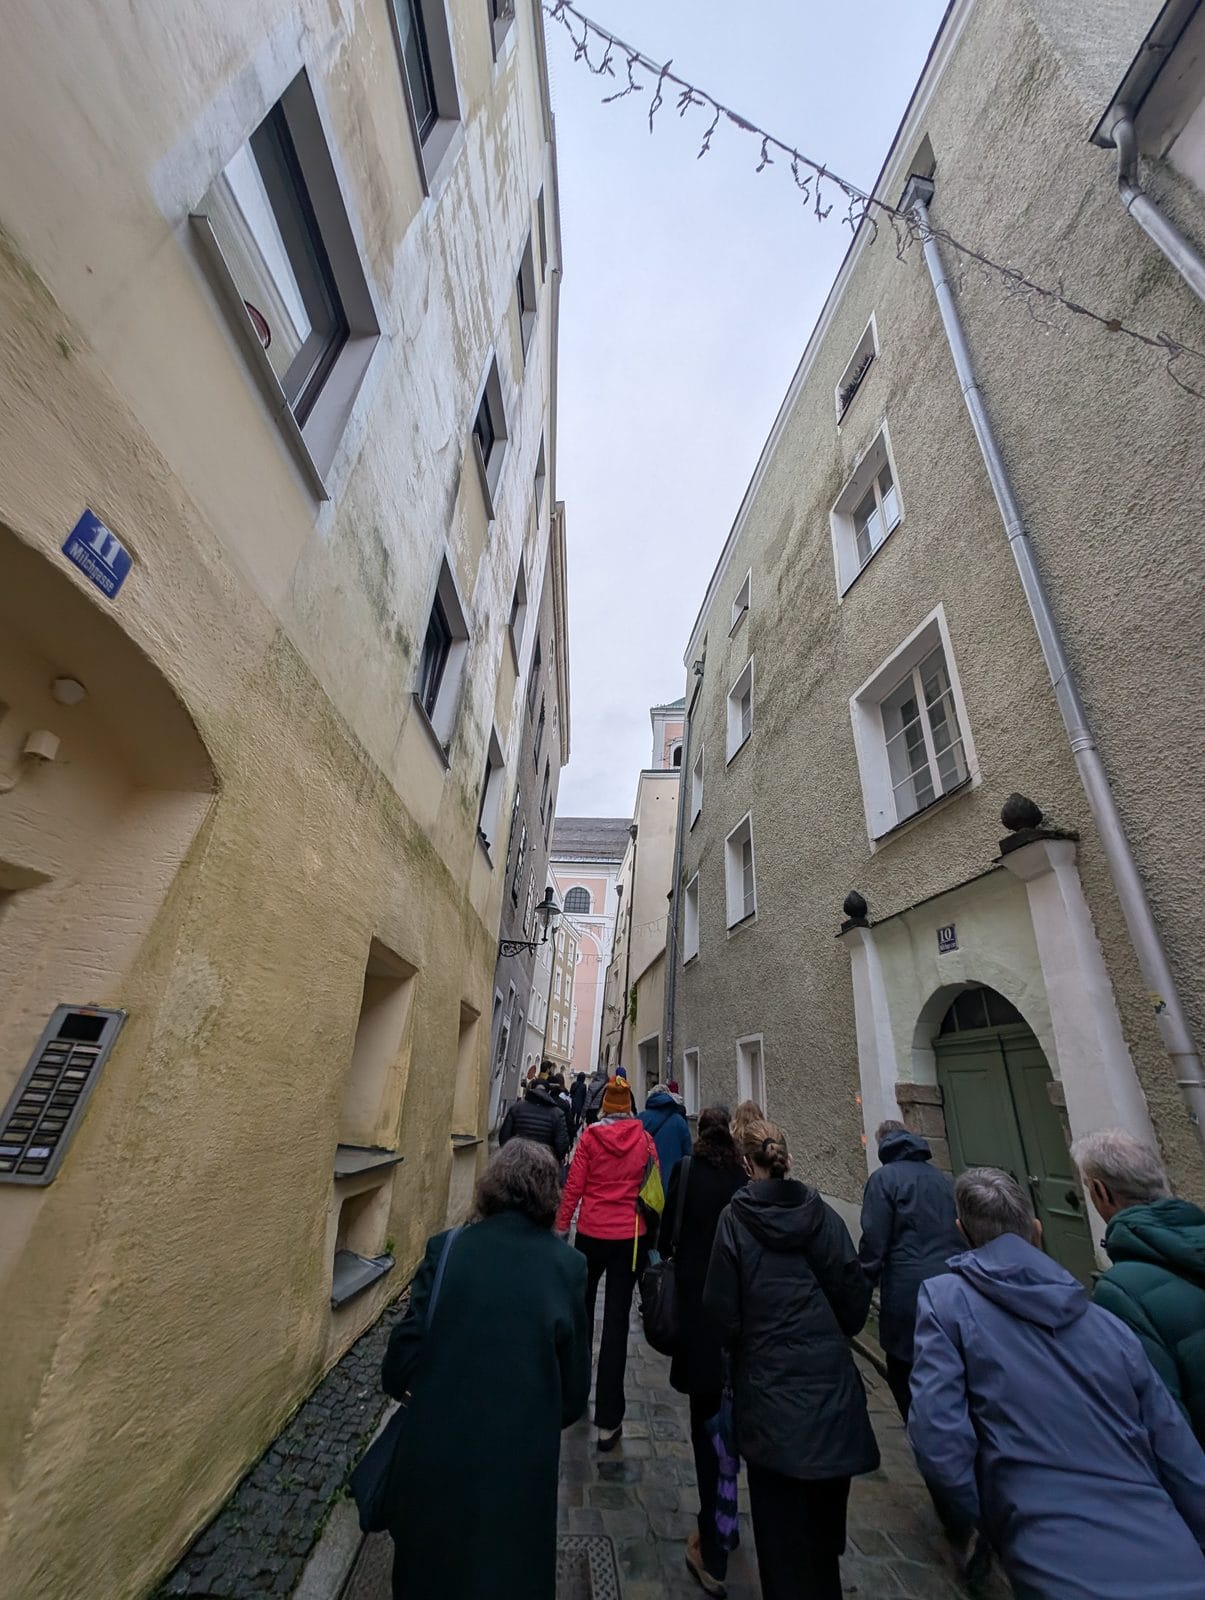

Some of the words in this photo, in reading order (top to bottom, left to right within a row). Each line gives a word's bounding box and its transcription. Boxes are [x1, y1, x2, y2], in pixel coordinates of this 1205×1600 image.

[70, 542, 114, 593] Milchgasse
[88, 525, 121, 568] 11
[940, 928, 951, 942] 10
